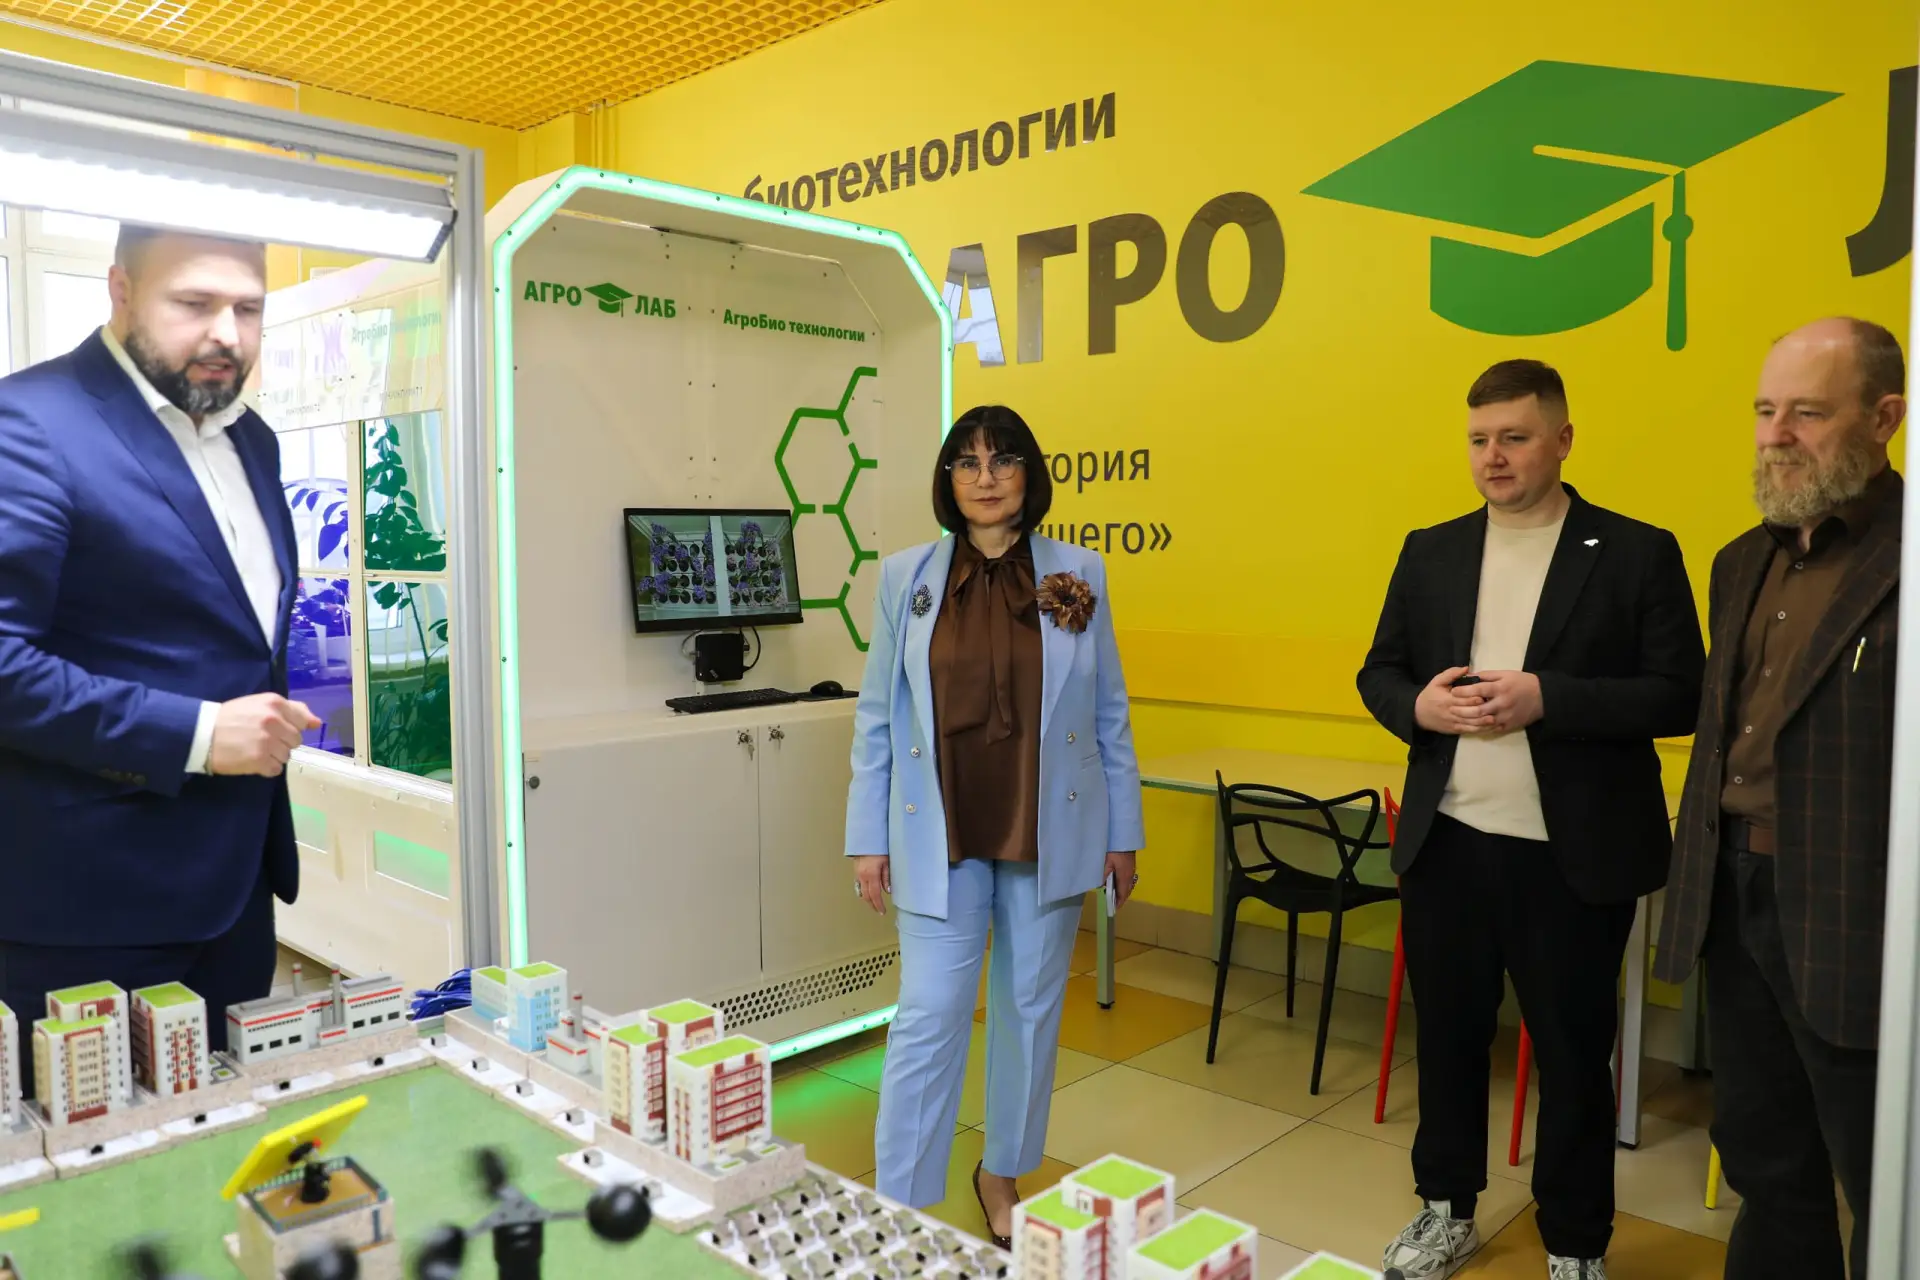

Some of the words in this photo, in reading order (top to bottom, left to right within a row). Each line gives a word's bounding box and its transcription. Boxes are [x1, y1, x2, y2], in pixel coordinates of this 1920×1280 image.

[942, 191, 1285, 368] АГРО
[524, 280, 582, 306] АГРО
[635, 295, 676, 318] ЛАБ
[723, 309, 786, 330] АгроБио
[788, 320, 866, 342] технологии
